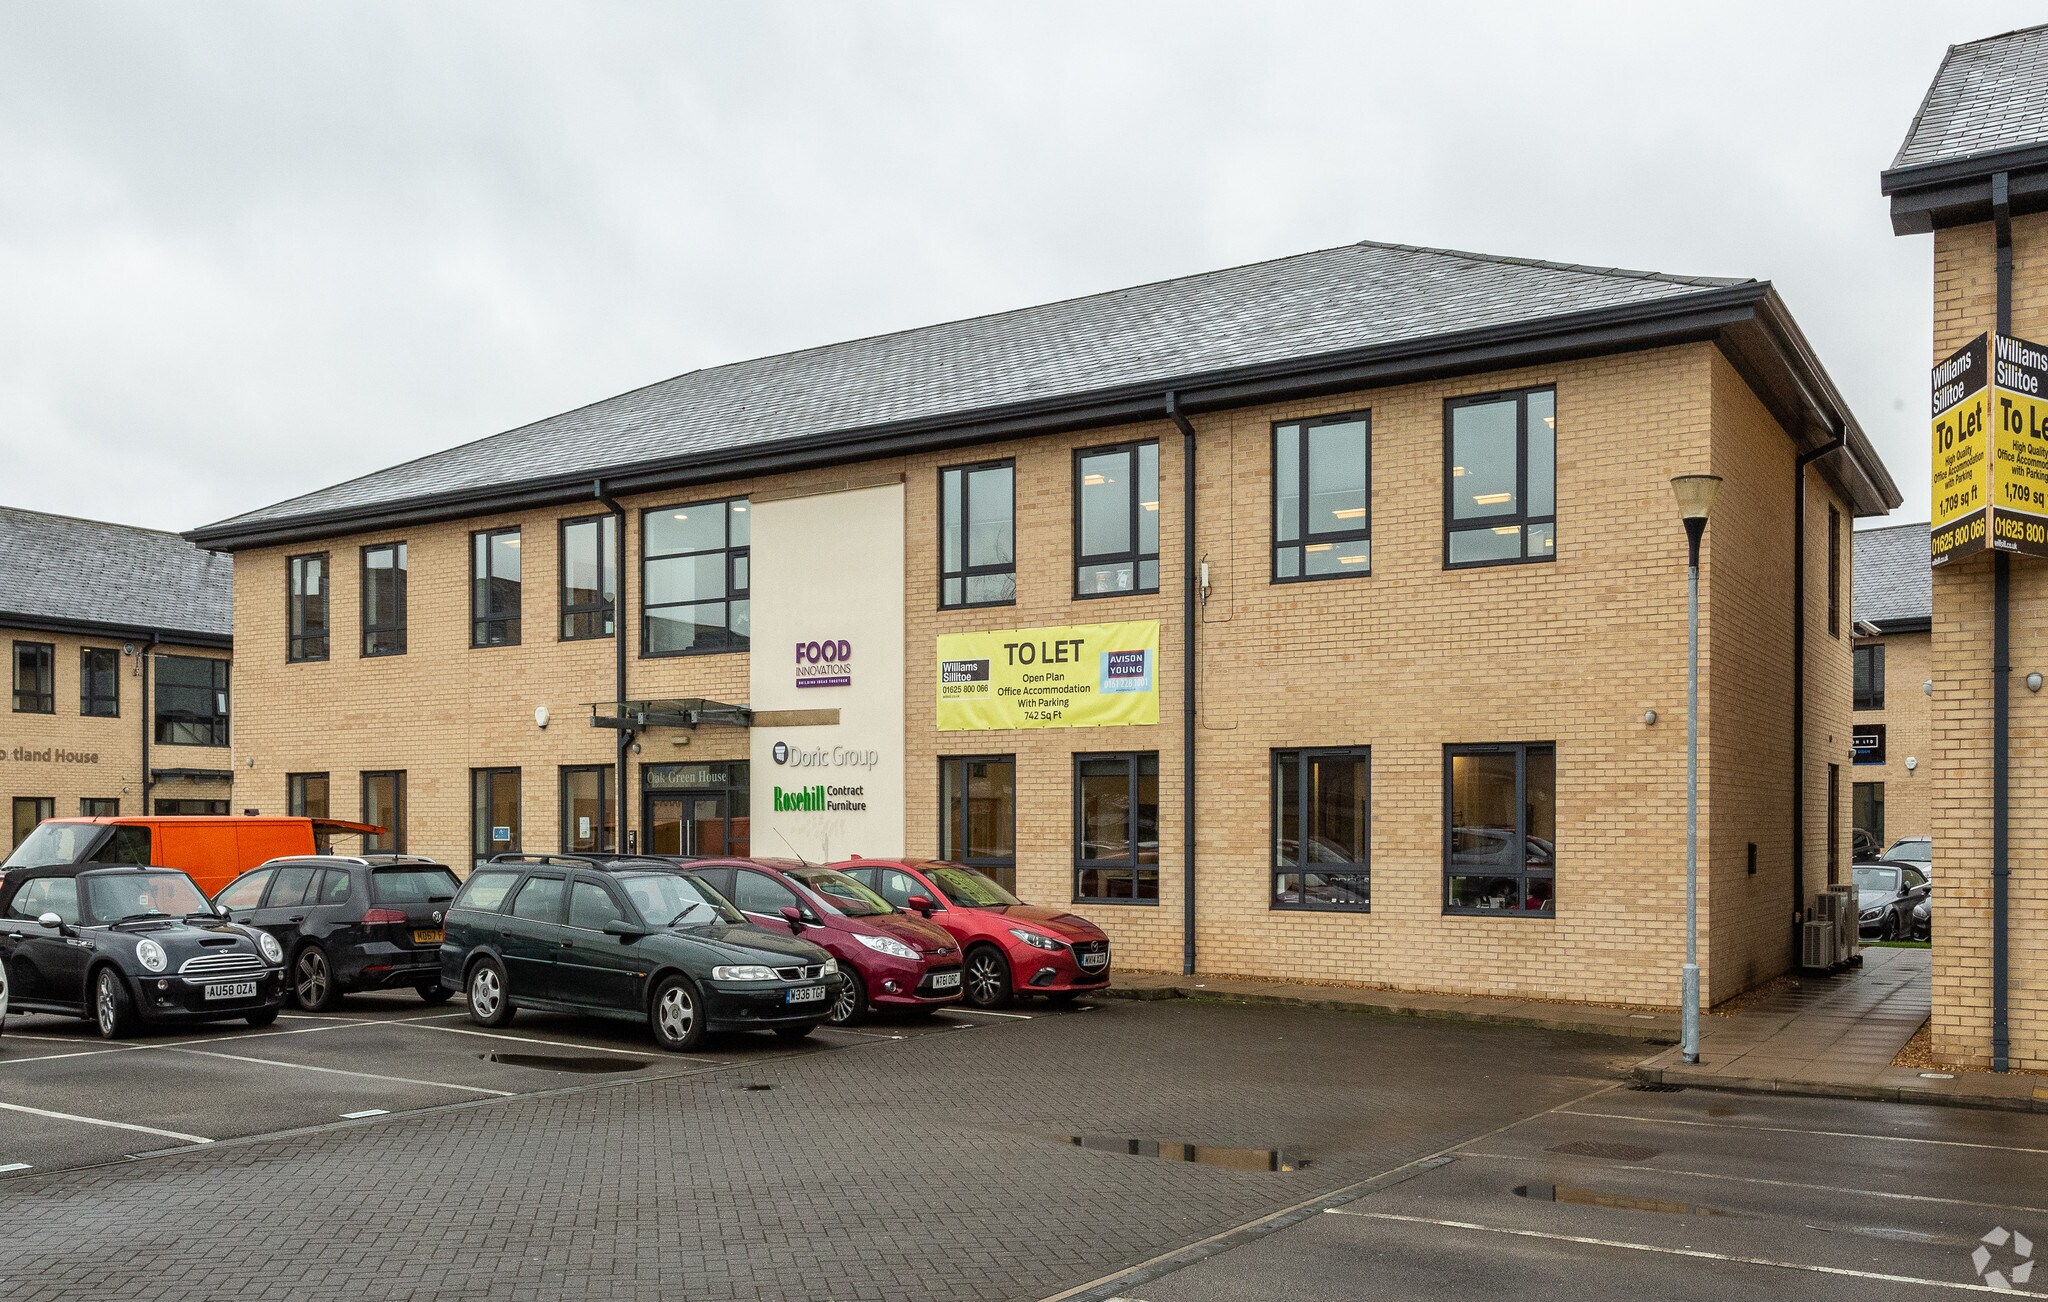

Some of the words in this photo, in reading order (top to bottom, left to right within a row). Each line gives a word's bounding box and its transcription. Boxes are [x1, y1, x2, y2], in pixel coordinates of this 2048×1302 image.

[1996, 335, 2048, 371] Williams
[1933, 351, 1971, 390] Williams
[1997, 361, 2038, 393] Sillitoe
[1933, 381, 1964, 413] Sillitoe
[2001, 397, 2022, 434] To
[1936, 421, 1953, 453] To
[1959, 401, 1982, 442] Let
[1945, 453, 1955, 466] High
[1957, 446, 1972, 460] Quality
[1998, 449, 2014, 462] Office
[2013, 440, 2026, 454] High
[1934, 471, 1947, 483] Office
[1948, 452, 1984, 477] Accommodation
[2012, 465, 2024, 476] with
[2026, 467, 2048, 484] Parking
[1945, 477, 1954, 489] with
[1956, 470, 1972, 484] Parking
[1940, 494, 1958, 517] 1,709
[1961, 492, 1969, 506] sq
[1971, 485, 1978, 500] ft
[2005, 482, 2029, 502] 1,709
[2033, 491, 2044, 508] sq
[1932, 531, 1953, 555] 01625
[1955, 525, 1969, 546] 800
[1971, 517, 1985, 540] 066
[1995, 517, 2023, 540] 01625
[2026, 523, 2044, 543] 800
[796, 640, 851, 664] FOOD
[1004, 642, 1036, 665] TO
[1042, 639, 1084, 663] LET
[1110, 654, 1143, 663] AVISON
[796, 664, 851, 676] INNOVATIONS
[943, 662, 978, 672] Williams
[1110, 665, 1143, 674] YOUNG
[943, 672, 972, 682] Sillitoe
[1022, 673, 1044, 683] Open
[1046, 672, 1065, 681] Plan
[1104, 680, 1119, 689] 0161
[943, 685, 961, 694] 01625
[963, 684, 975, 693] 800
[977, 684, 988, 692] 066
[997, 686, 1021, 696] Office
[1023, 684, 1090, 695] Accommodation
[1018, 699, 1036, 708] With
[1038, 698, 1069, 707] Parking
[1024, 711, 1039, 720] 742
[1041, 711, 1052, 720] Sq
[1053, 710, 1062, 719] Ft
[55, 748, 99, 763] House
[790, 746, 829, 767] Doric
[833, 745, 879, 771] Group
[647, 771, 665, 783] Oak
[668, 771, 695, 783] Green
[699, 770, 727, 783] House
[774, 785, 825, 811] Rosehill
[827, 785, 864, 796] Contract
[827, 800, 867, 811] Furniture
[210, 985, 234, 996] AU58
[236, 984, 253, 995] OZA
